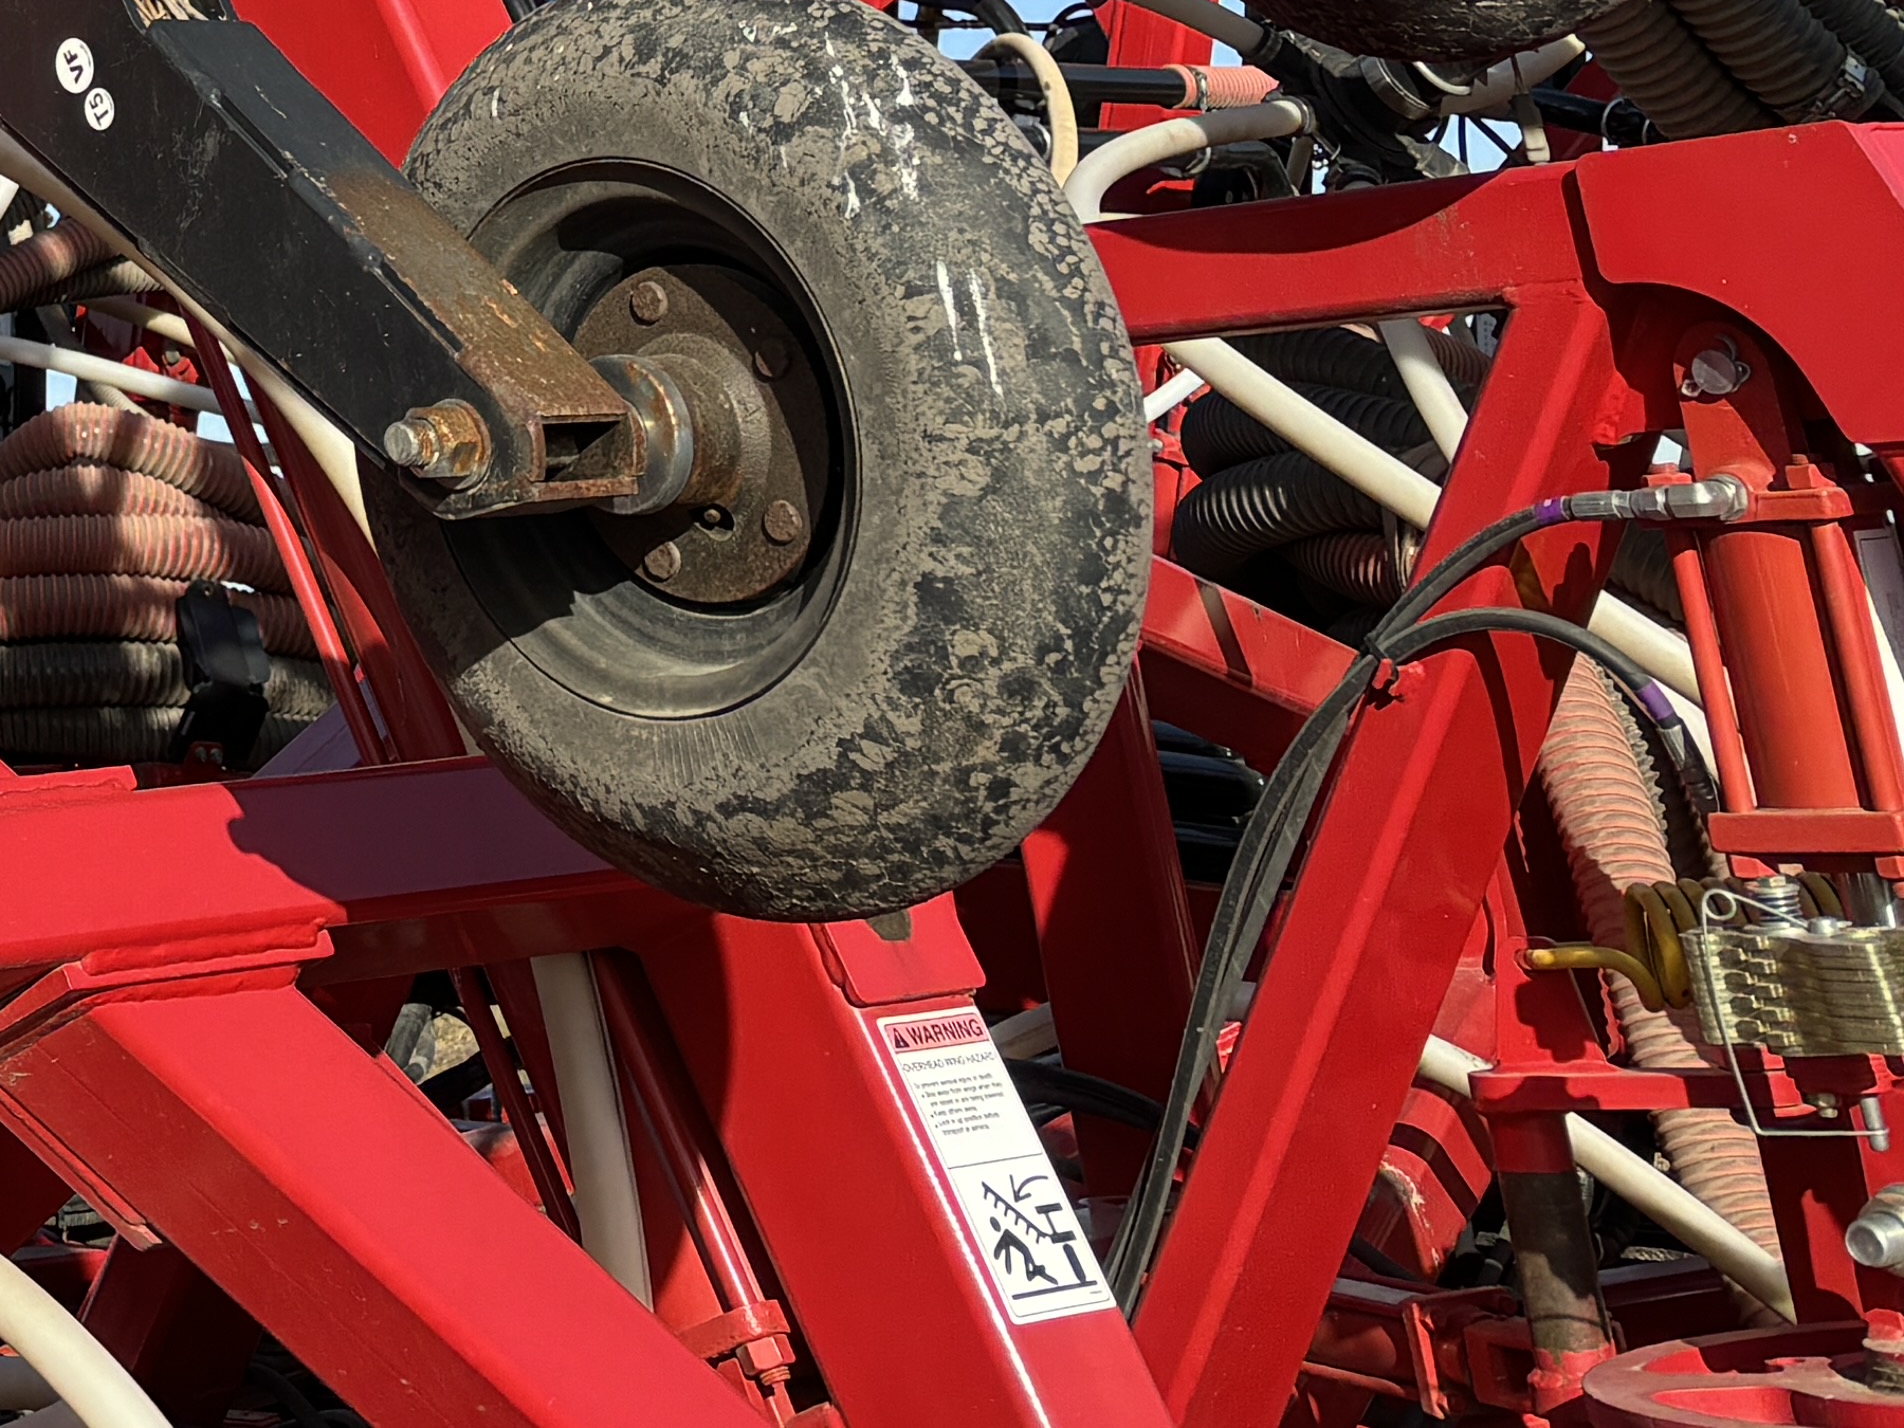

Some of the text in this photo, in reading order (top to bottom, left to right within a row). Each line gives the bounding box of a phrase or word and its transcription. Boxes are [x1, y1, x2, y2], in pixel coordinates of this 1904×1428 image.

[63, 49, 84, 84] VF
[89, 92, 109, 127] T5
[906, 1019, 983, 1045] WARNING
